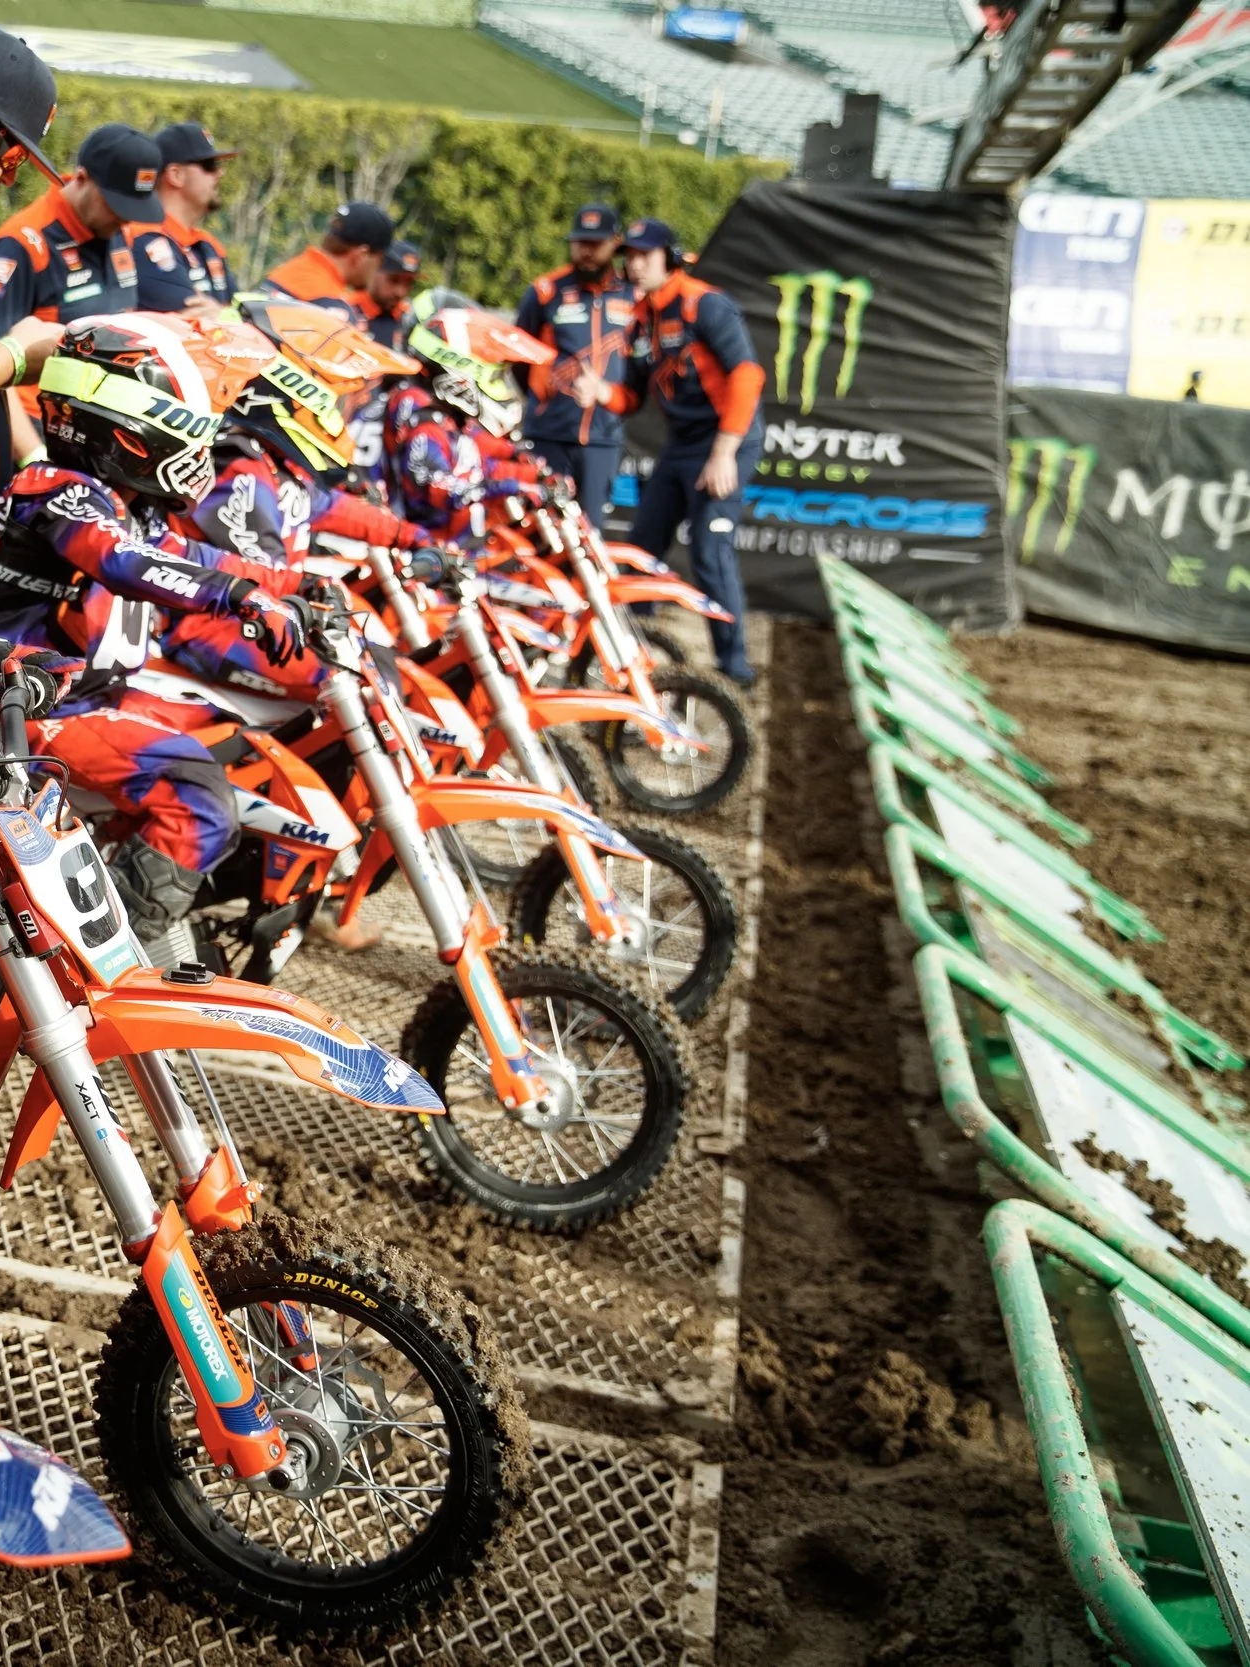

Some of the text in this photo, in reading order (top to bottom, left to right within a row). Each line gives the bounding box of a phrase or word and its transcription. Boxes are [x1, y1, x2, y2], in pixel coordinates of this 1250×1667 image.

[270, 361, 328, 410] 100%
[764, 419, 906, 466] NSTER
[756, 458, 871, 484] NERGY
[142, 565, 200, 599] KTM
[420, 726, 457, 744] KTM
[279, 821, 330, 846] KTM
[59, 842, 122, 949] 9
[198, 1007, 301, 1032] Troy Lee Designs
[74, 1081, 101, 1120] XACT
[294, 1272, 380, 1311] DUNLOP
[193, 1268, 248, 1375] DUNLOP
[185, 1308, 229, 1382] MOTOREX
